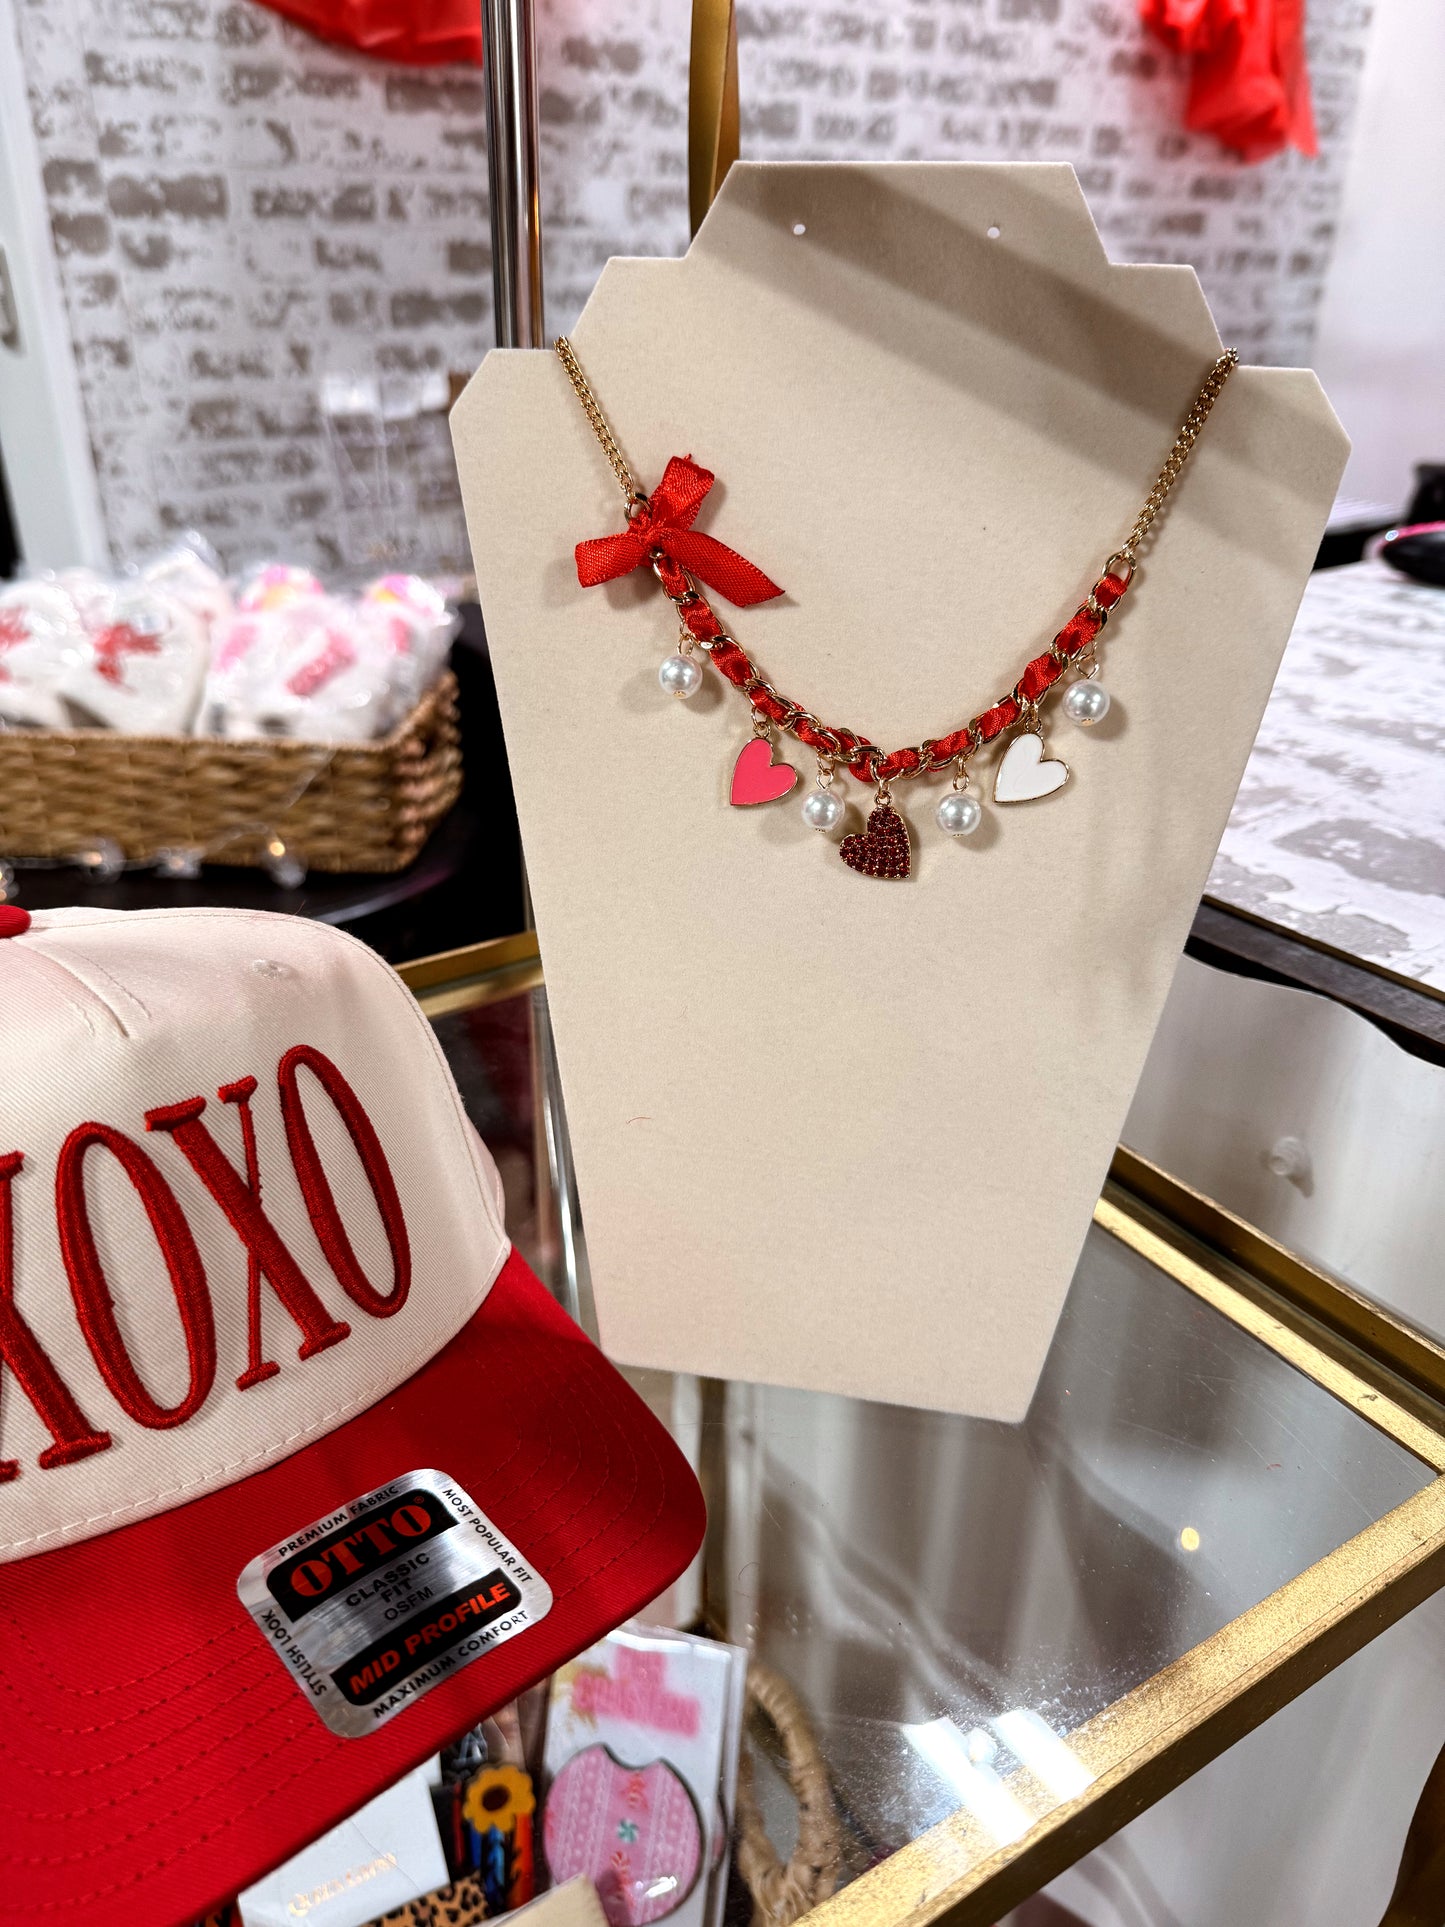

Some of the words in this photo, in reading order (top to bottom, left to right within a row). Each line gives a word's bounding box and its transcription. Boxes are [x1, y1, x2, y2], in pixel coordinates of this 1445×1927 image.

[279, 1513, 348, 1557] PREMIUM
[349, 1485, 399, 1515] FABRIC
[290, 1504, 431, 1597] OTTO
[443, 1488, 473, 1518] MOST
[469, 1517, 515, 1567] POPULAR
[513, 1566, 533, 1584] FIT
[346, 1552, 430, 1607] CLASSIC
[382, 1577, 412, 1602] FIT
[384, 1586, 434, 1622] OSFM
[261, 1608, 292, 1643] LOOK
[349, 1649, 401, 1695] MID
[403, 1582, 511, 1656] PROFILE
[289, 1643, 327, 1697] STYLISH
[373, 1655, 456, 1719] MAXIMUM
[457, 1610, 529, 1658] COMFORT
